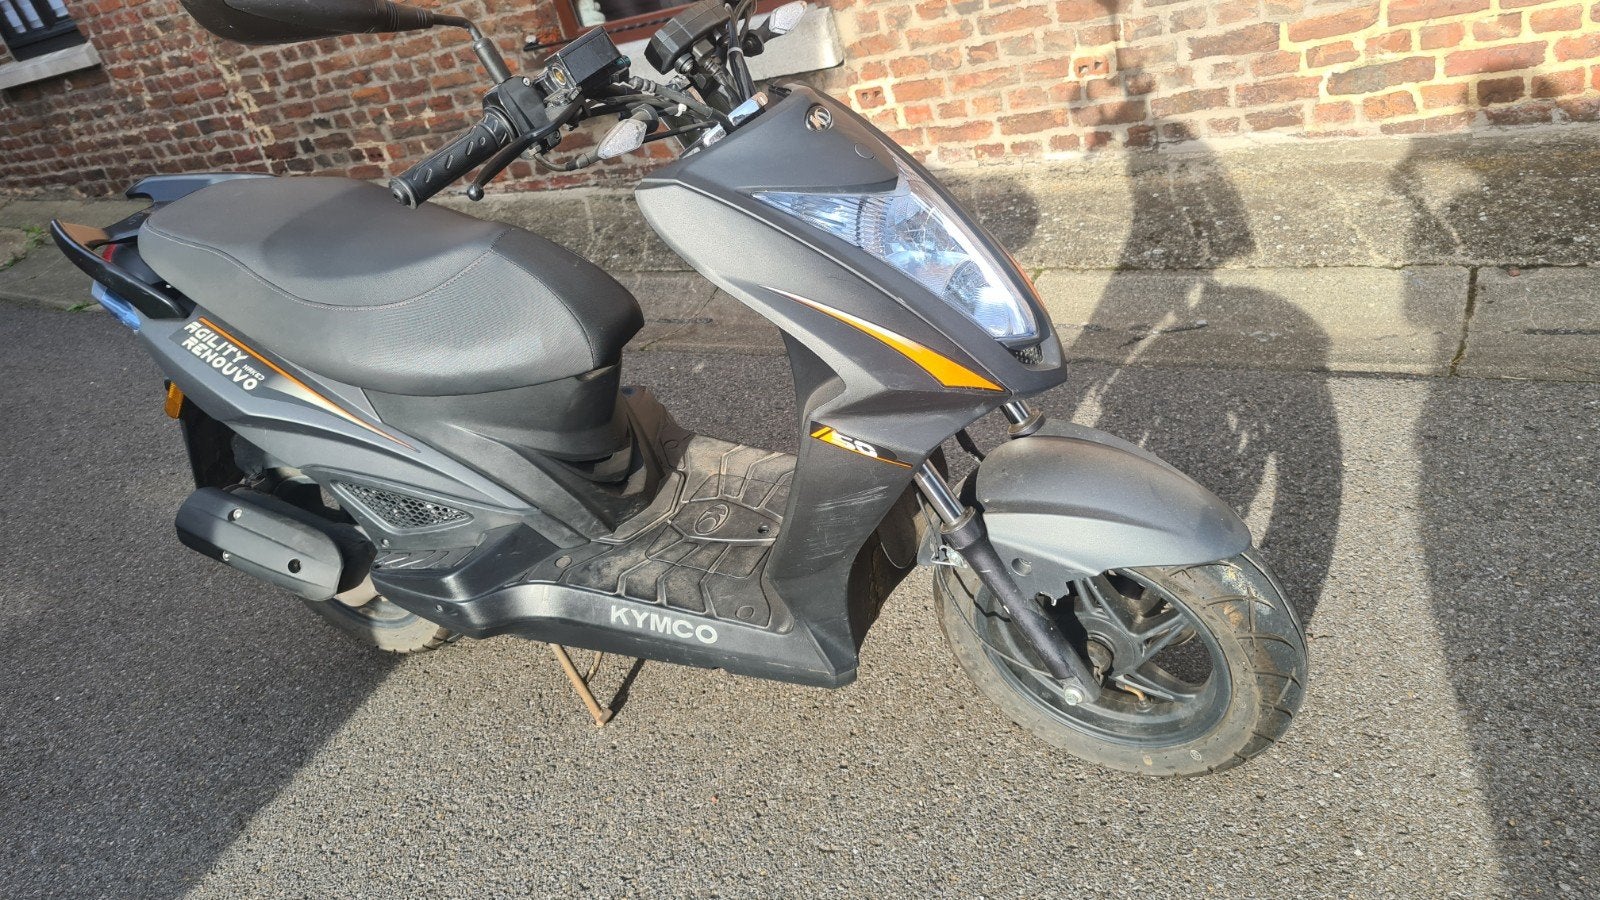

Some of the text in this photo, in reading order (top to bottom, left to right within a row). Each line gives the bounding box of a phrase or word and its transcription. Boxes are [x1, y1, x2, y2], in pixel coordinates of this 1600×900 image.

[181, 336, 258, 390] RENOUVO
[183, 321, 248, 363] AGILITY
[610, 605, 718, 644] KYMCO
